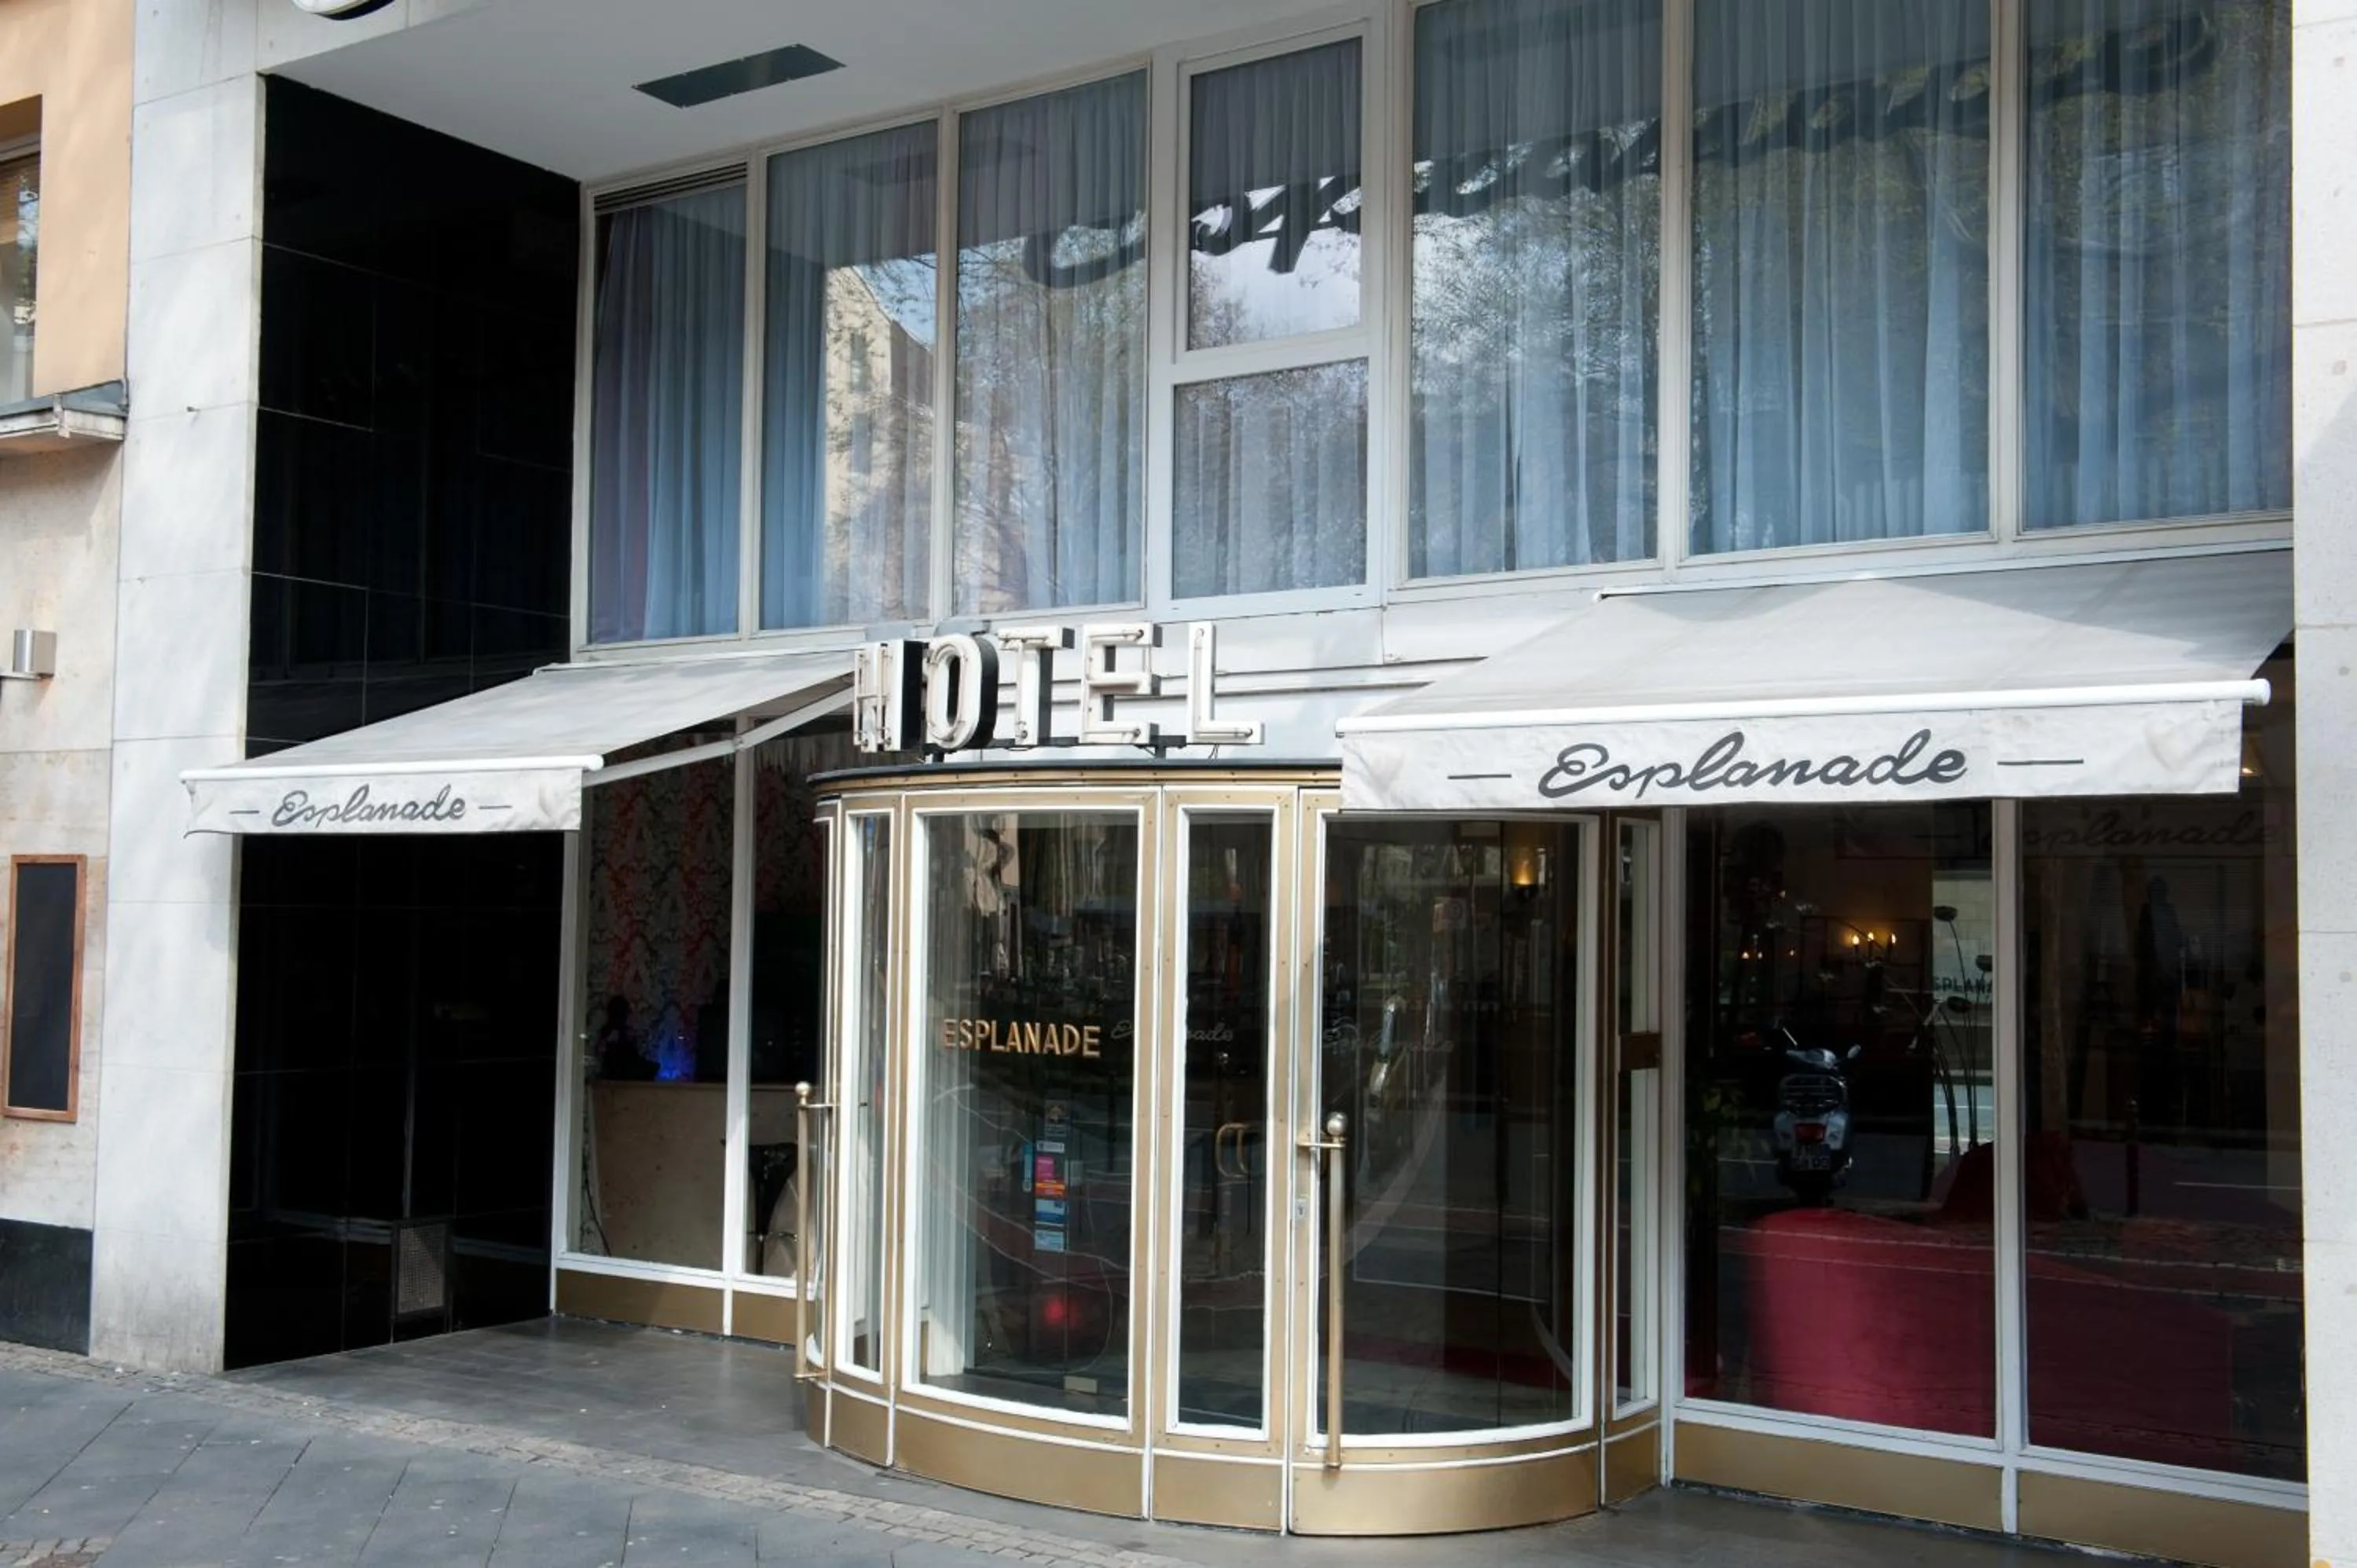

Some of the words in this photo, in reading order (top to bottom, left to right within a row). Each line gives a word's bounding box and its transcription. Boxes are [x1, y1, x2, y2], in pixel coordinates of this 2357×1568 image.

[854, 621, 1264, 753] HOTEL
[1538, 728, 1968, 799] Esplanade
[272, 784, 466, 828] Esplanade
[943, 1018, 1102, 1057] ESPLANADE
